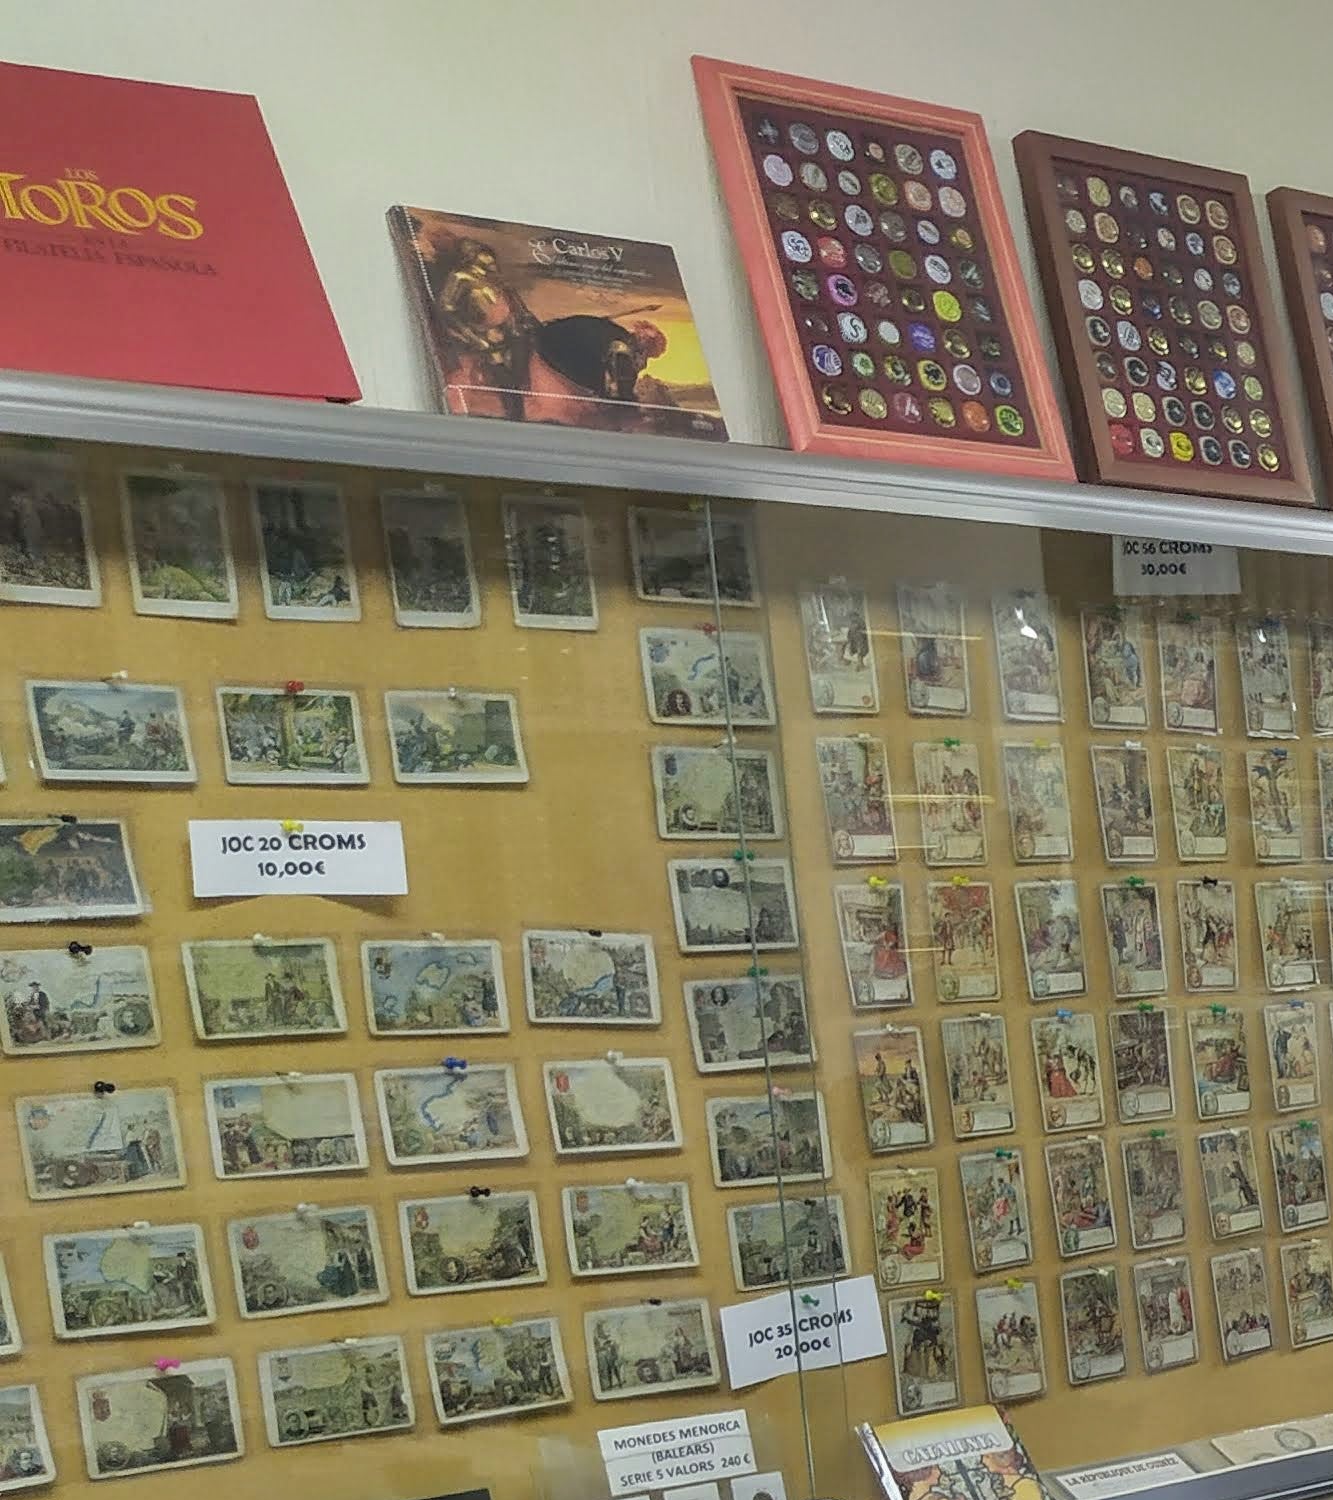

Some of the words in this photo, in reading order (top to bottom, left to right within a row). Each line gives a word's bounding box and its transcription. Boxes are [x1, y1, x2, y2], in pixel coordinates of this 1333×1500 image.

[552, 239, 609, 260] Carlos
[608, 244, 624, 262] V
[222, 836, 254, 855] JOC
[259, 837, 283, 851] 20
[288, 833, 367, 850] CROMS
[258, 861, 326, 878] 10,00€
[749, 1327, 774, 1348] JOC
[777, 1323, 793, 1338] 35
[798, 1308, 854, 1332] CROMS
[775, 1336, 832, 1360] 20,00€
[614, 1430, 676, 1451] MONEDES
[680, 1420, 740, 1441] MENORCA
[652, 1442, 715, 1464] (BALEARS)
[902, 1431, 1001, 1466] CATALUNYA
[620, 1471, 654, 1487] SERIE
[656, 1469, 664, 1480] 5
[666, 1460, 715, 1477] VALORS
[721, 1456, 741, 1469] 240
[742, 1453, 751, 1464] €
